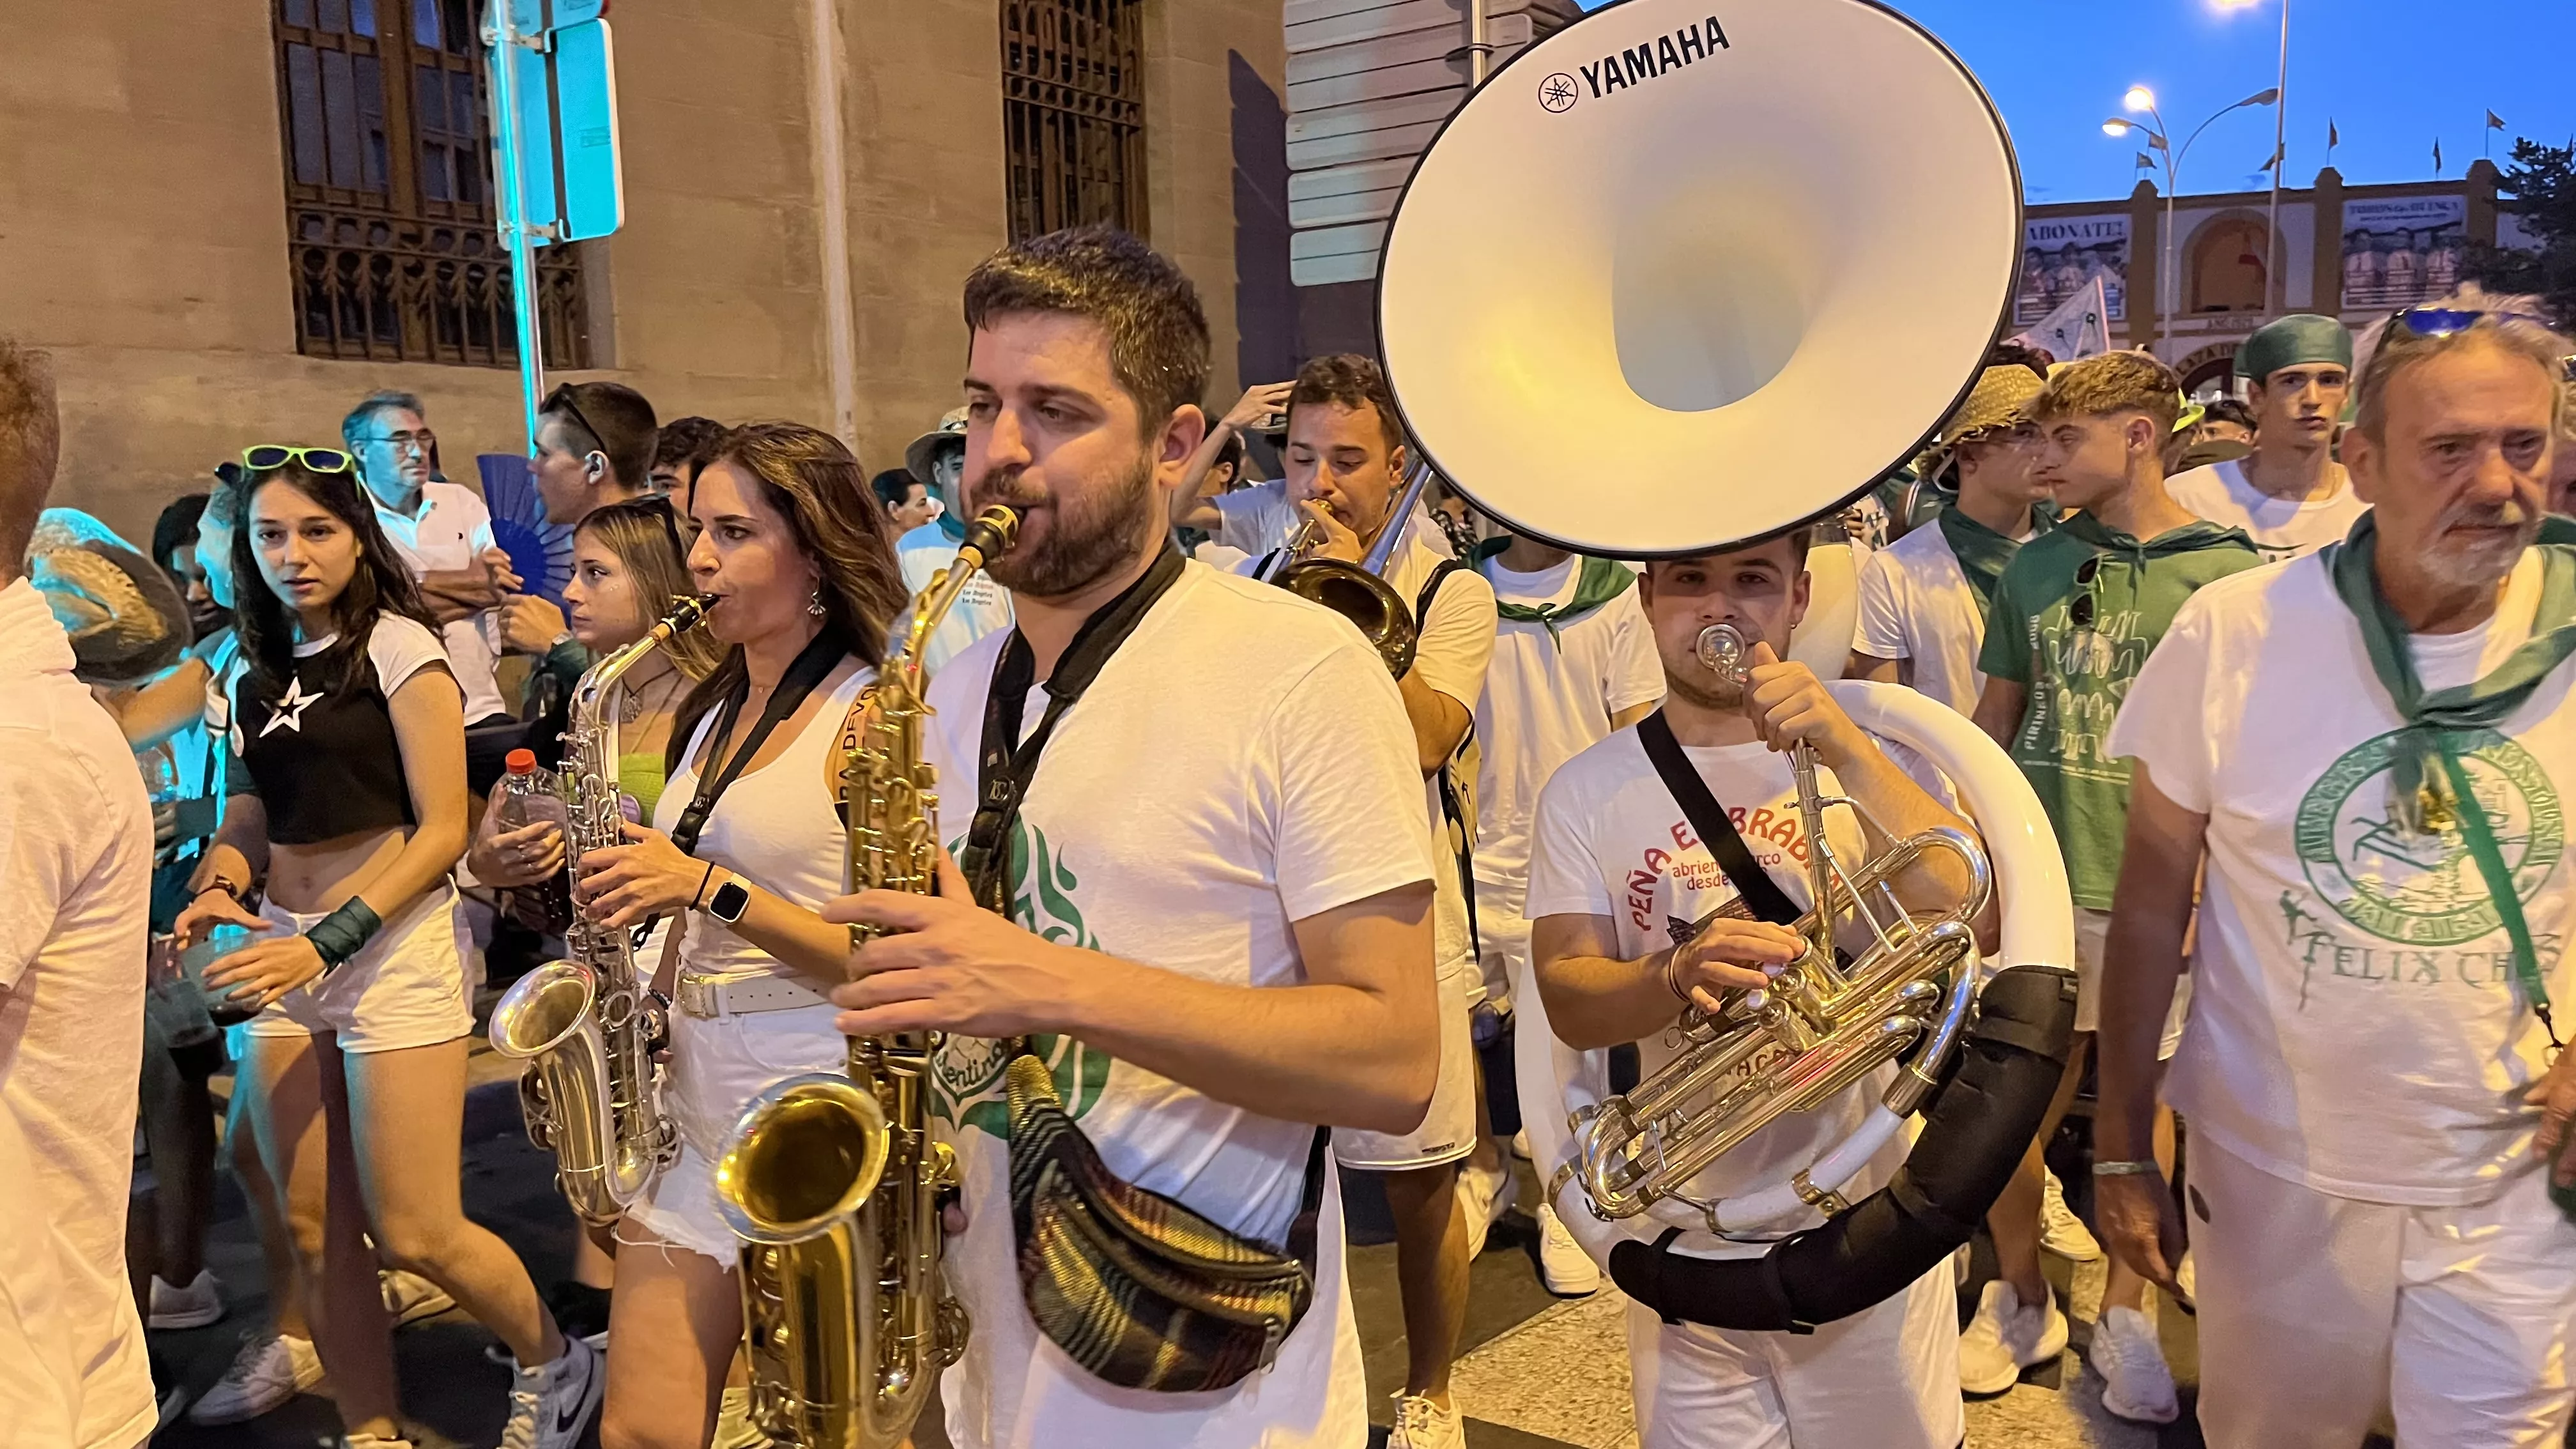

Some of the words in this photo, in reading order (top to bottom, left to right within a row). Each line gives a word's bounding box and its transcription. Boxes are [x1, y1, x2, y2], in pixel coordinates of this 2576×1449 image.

[1579, 16, 1730, 98] YAMAHA
[1626, 848, 1673, 931] PEÑA
[1669, 820, 1702, 851] E
[1672, 860, 1721, 878] abrien
[1687, 873, 1729, 891] desde
